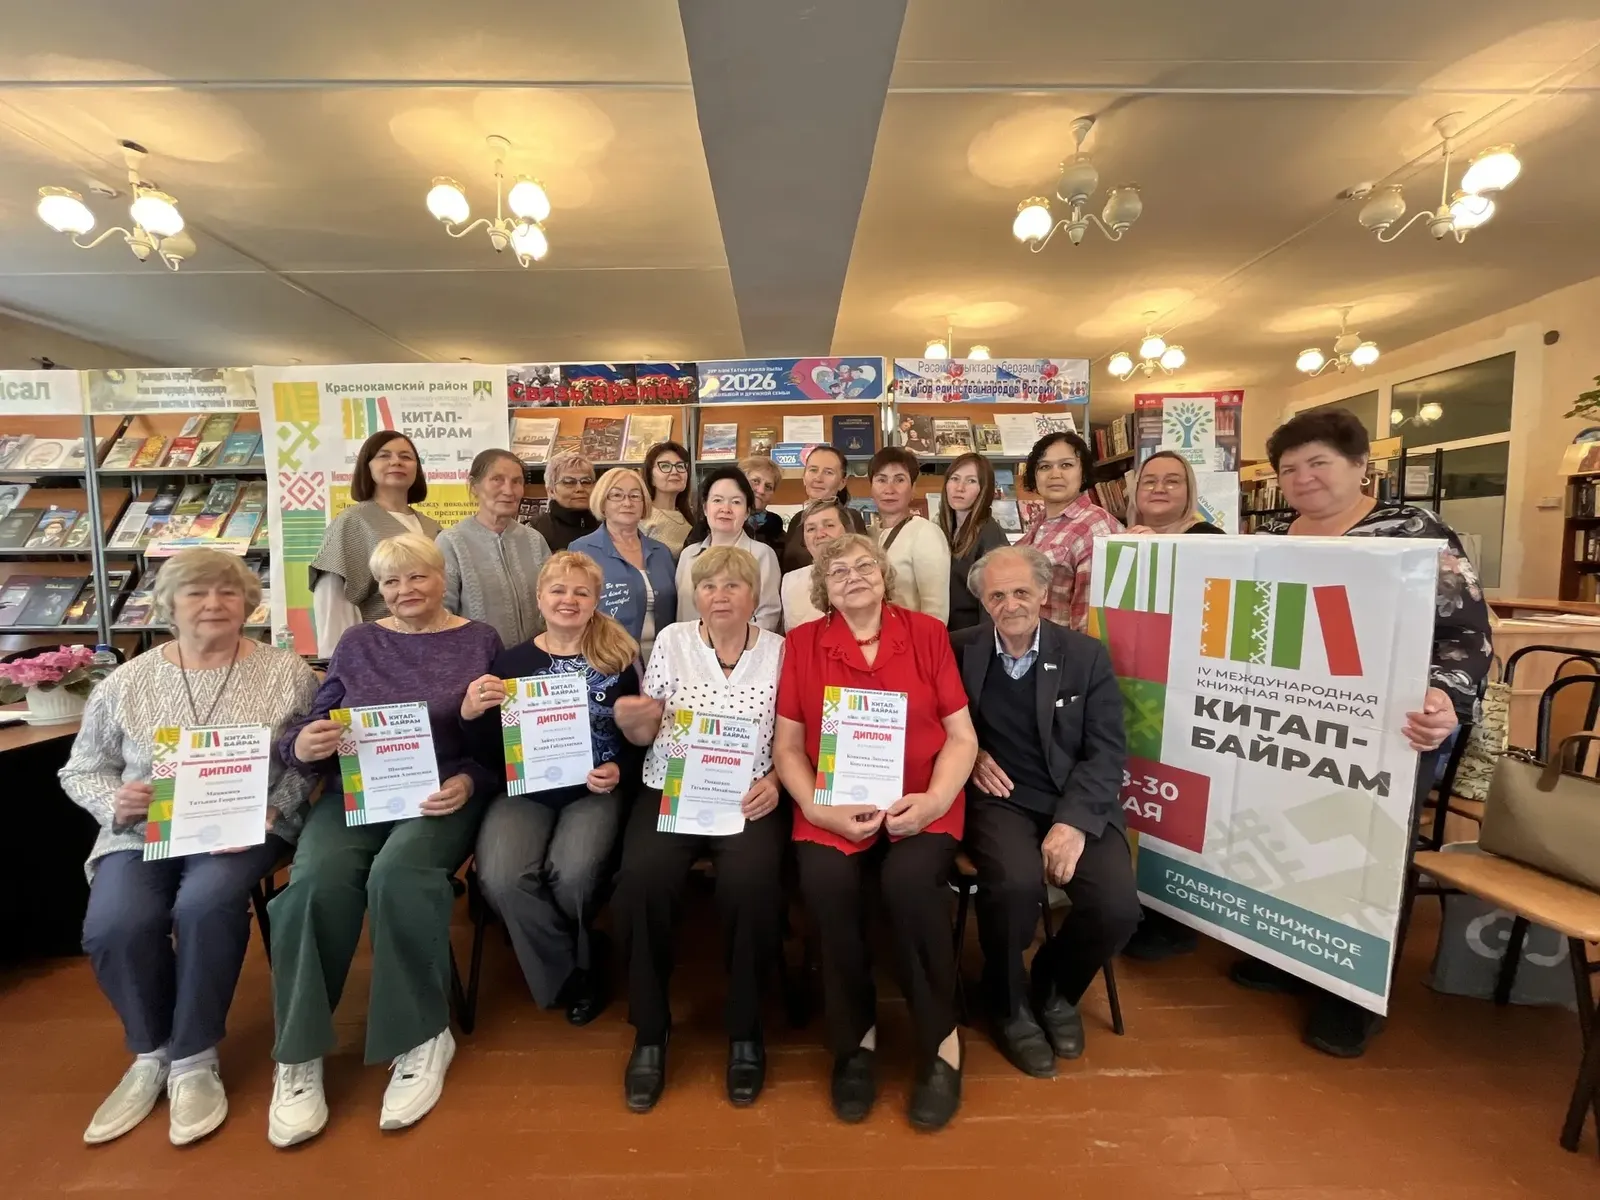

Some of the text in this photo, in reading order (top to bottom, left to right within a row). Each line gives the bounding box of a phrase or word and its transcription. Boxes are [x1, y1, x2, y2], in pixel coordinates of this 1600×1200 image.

[0, 377, 51, 400] сал
[325, 380, 468, 394] Краснокамский район
[720, 373, 777, 391] 2026
[508, 383, 585, 401] Связь
[401, 411, 463, 423] КИТАП-
[403, 424, 472, 438] БАЙРАМ
[1197, 666, 1379, 706] IV МЕЖДУНАРОДНАЯ
[1196, 679, 1375, 720] КНИЖНАЯ ЯРМАРКА
[537, 712, 577, 725] ДИПЛОМ
[1193, 694, 1368, 749] КИТАП-
[853, 730, 892, 742] ДИПЛОМ
[376, 742, 420, 755] ДИПЛОМ
[701, 754, 742, 767] ДИПЛОМ
[1191, 725, 1392, 798] БАЙРАМ
[198, 764, 252, 778] ДИПЛОМ
[1118, 793, 1163, 823] АЯ
[1165, 868, 1363, 958] ГЛАВНОЕ КНИЖНОЕ
[1165, 883, 1356, 971] СОБЫТИЕ РЕГИОНА
